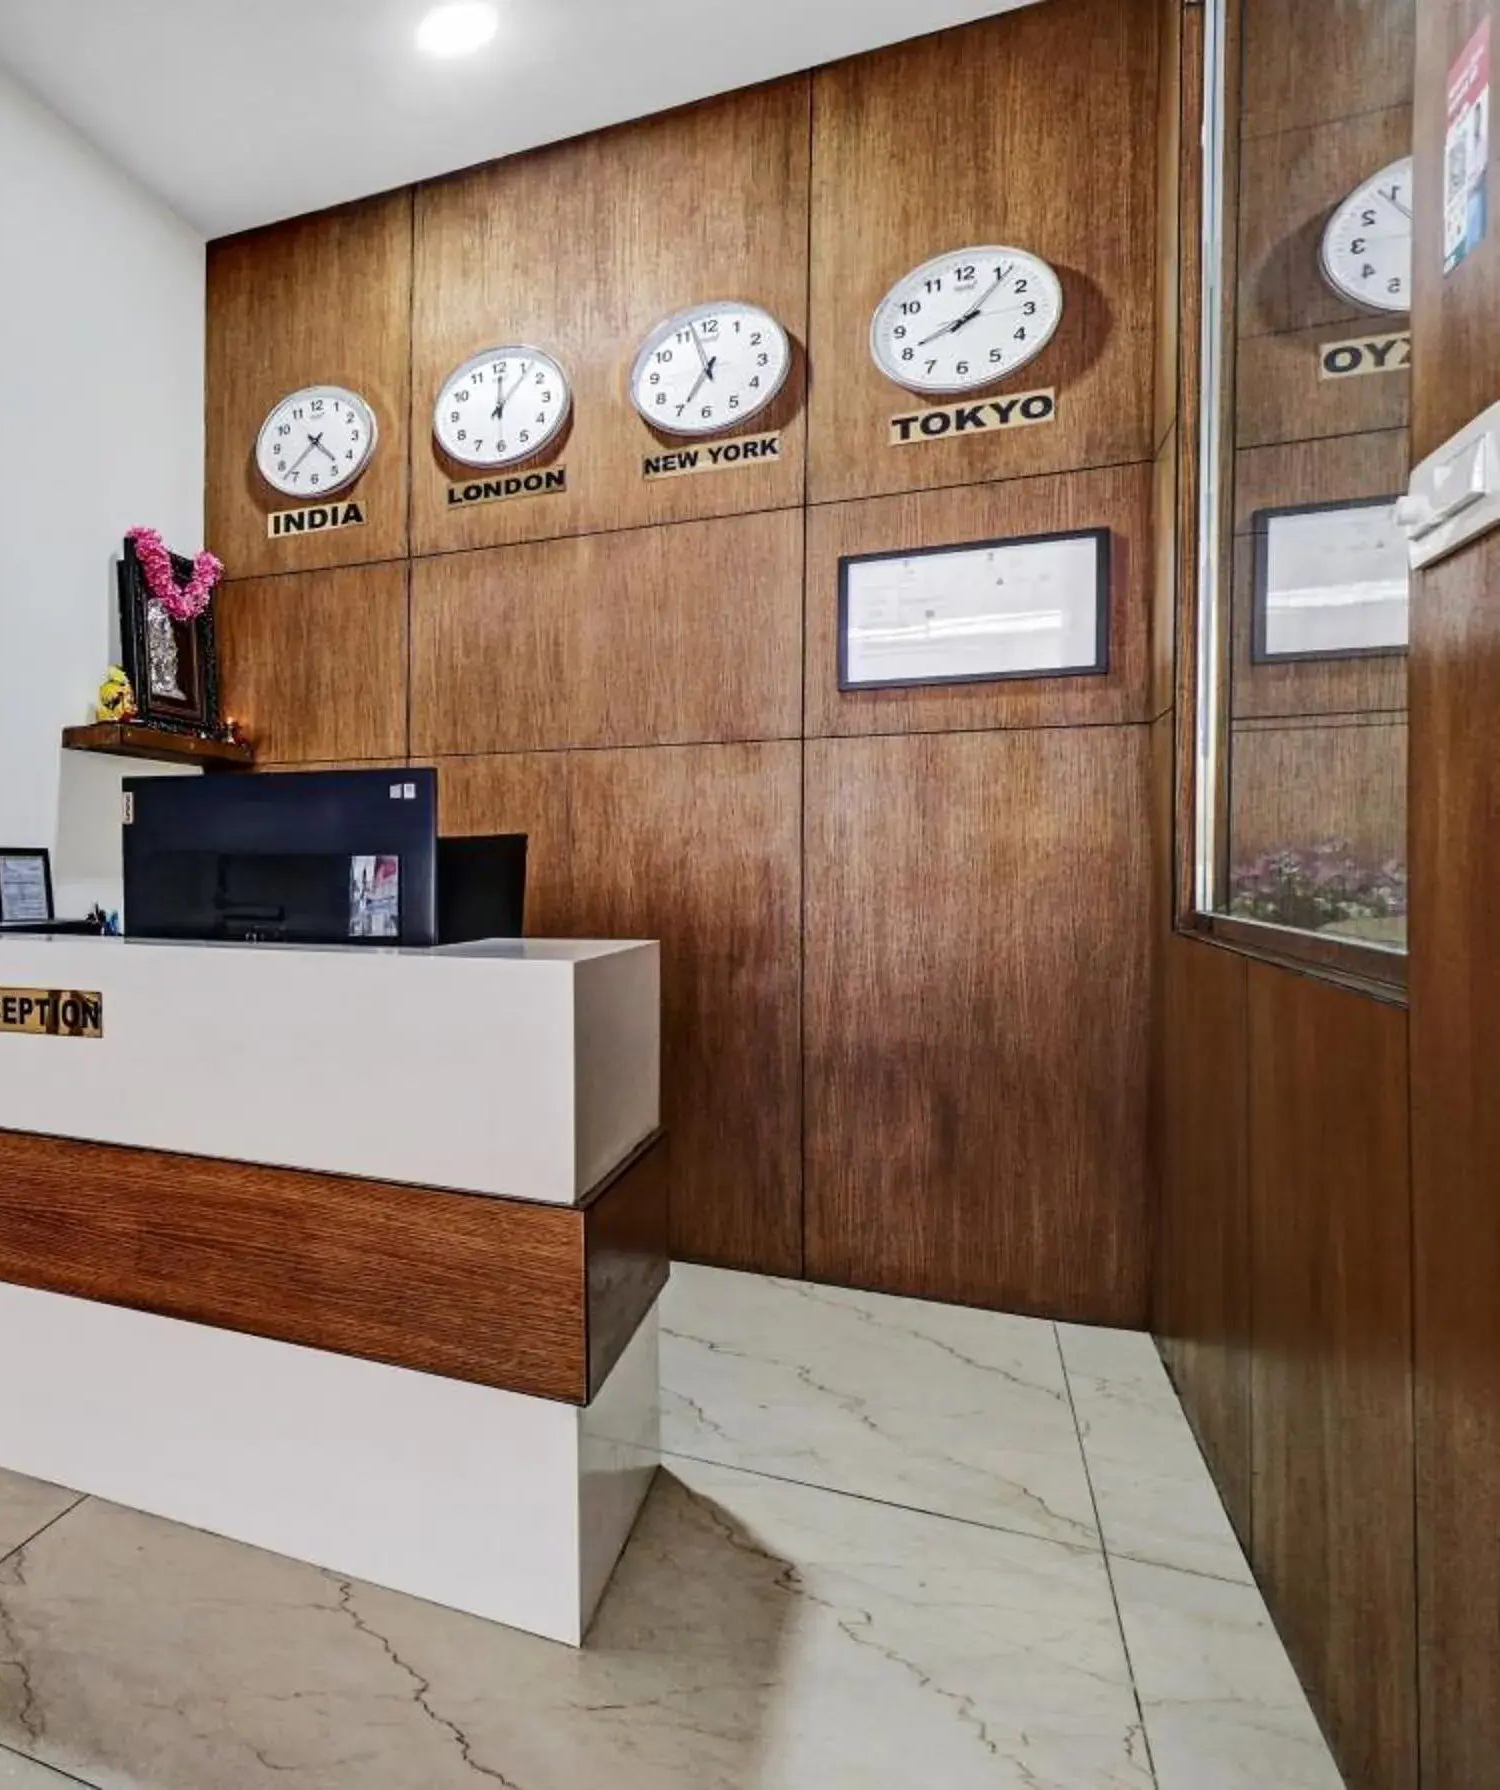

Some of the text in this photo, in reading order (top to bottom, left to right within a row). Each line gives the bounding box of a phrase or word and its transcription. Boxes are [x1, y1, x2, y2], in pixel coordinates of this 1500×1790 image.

[955, 266, 975, 281] 12
[994, 267, 1001, 280] 1
[925, 280, 941, 293] 11
[1014, 280, 1027, 293] 2
[901, 301, 921, 315] 10
[1023, 302, 1035, 315] 3
[702, 320, 718, 333] 12
[734, 321, 740, 332] 1
[894, 326, 906, 339] 9
[676, 331, 690, 344] 11
[751, 333, 761, 345] 2
[1014, 327, 1025, 340] 4
[656, 350, 672, 363] 10
[757, 353, 768, 366] 3
[902, 348, 914, 360] 8
[990, 349, 1001, 362] 5
[492, 362, 506, 374] 12
[520, 363, 525, 373] 1
[925, 360, 937, 374] 7
[957, 362, 968, 374] 6
[472, 372, 483, 384] 11
[536, 372, 545, 384] 2
[650, 374, 660, 384] 9
[749, 376, 758, 388] 4
[454, 390, 469, 402] 10
[542, 391, 550, 402] 3
[656, 393, 666, 405] 8
[729, 396, 738, 408] 5
[310, 400, 323, 411] 12
[334, 402, 339, 411] 1
[676, 405, 684, 417] 7
[293, 409, 302, 419] 11
[452, 412, 460, 422] 9
[536, 412, 544, 423] 4
[702, 406, 711, 418] 6
[892, 395, 1053, 440] TOKYO
[347, 413, 354, 424] 2
[278, 424, 290, 435] 10
[351, 430, 359, 441] 3
[458, 430, 466, 440] 8
[520, 430, 528, 442] 5
[274, 444, 280, 454] 9
[475, 440, 482, 451] 7
[497, 440, 506, 452] 6
[345, 450, 352, 459] 4
[643, 438, 778, 474] NEW YORK
[278, 460, 285, 471] 8
[331, 466, 338, 476] 5
[292, 472, 299, 483] 7
[311, 474, 318, 484] 6
[448, 470, 564, 504] LONDON
[274, 504, 362, 534] INDIA
